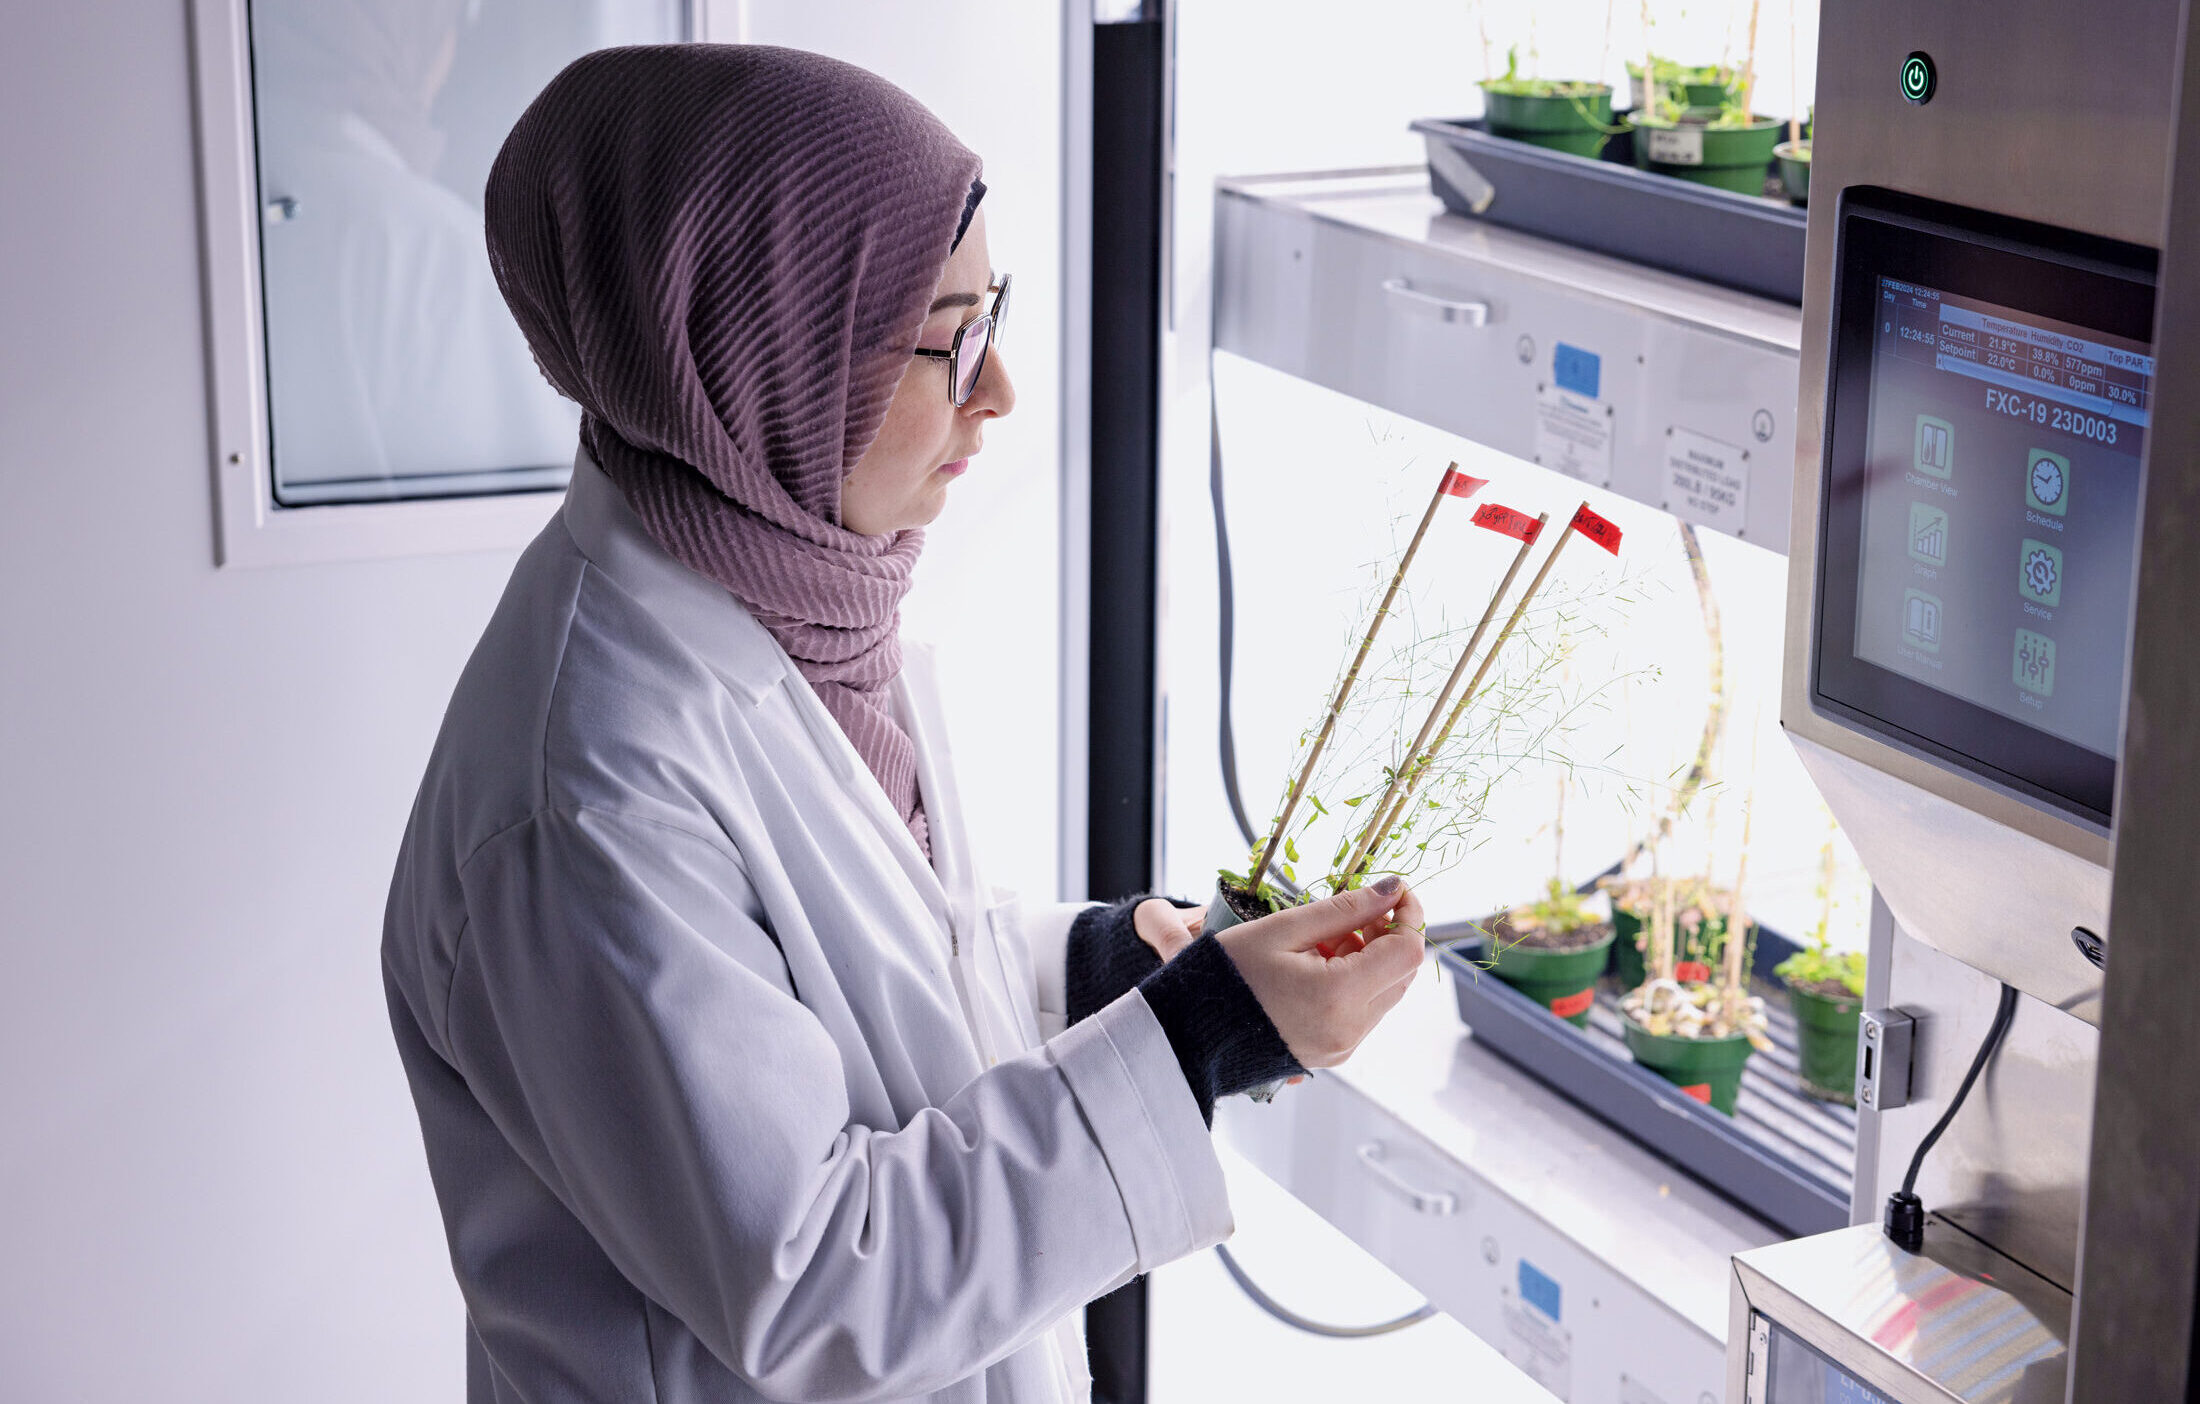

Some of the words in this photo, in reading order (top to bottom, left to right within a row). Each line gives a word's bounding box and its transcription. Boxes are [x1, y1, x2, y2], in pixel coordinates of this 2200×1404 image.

[1881, 279, 1913, 294] 27FEB2024
[1915, 287, 1940, 301] 12:24:55
[1884, 290, 1896, 302] Day
[1912, 298, 1927, 309] Time
[1900, 326, 1936, 345] 12:24:55
[1982, 317, 2028, 338] Temperature
[2031, 331, 2064, 350] Humidity
[2066, 340, 2085, 353] CO2
[2108, 350, 2123, 365] Top
[2125, 356, 2144, 370] PAR
[1942, 324, 1976, 343] Current
[2032, 347, 2059, 366] 39.8%
[2065, 356, 2102, 378] 577ppm
[1939, 340, 1977, 360] Setpoint
[1987, 352, 2016, 370] 22.0°C
[2033, 365, 2055, 382] 0.0%
[2069, 375, 2096, 393] 0ppm
[2108, 385, 2137, 405] 30.0%
[1985, 388, 2047, 424] FXC-19
[2051, 407, 2118, 444] 23D003
[1941, 484, 1960, 498] View
[2026, 510, 2064, 532] Schedule
[1912, 562, 1937, 581] Graph
[2023, 601, 2052, 622] Service
[2019, 691, 2043, 710] Setup
